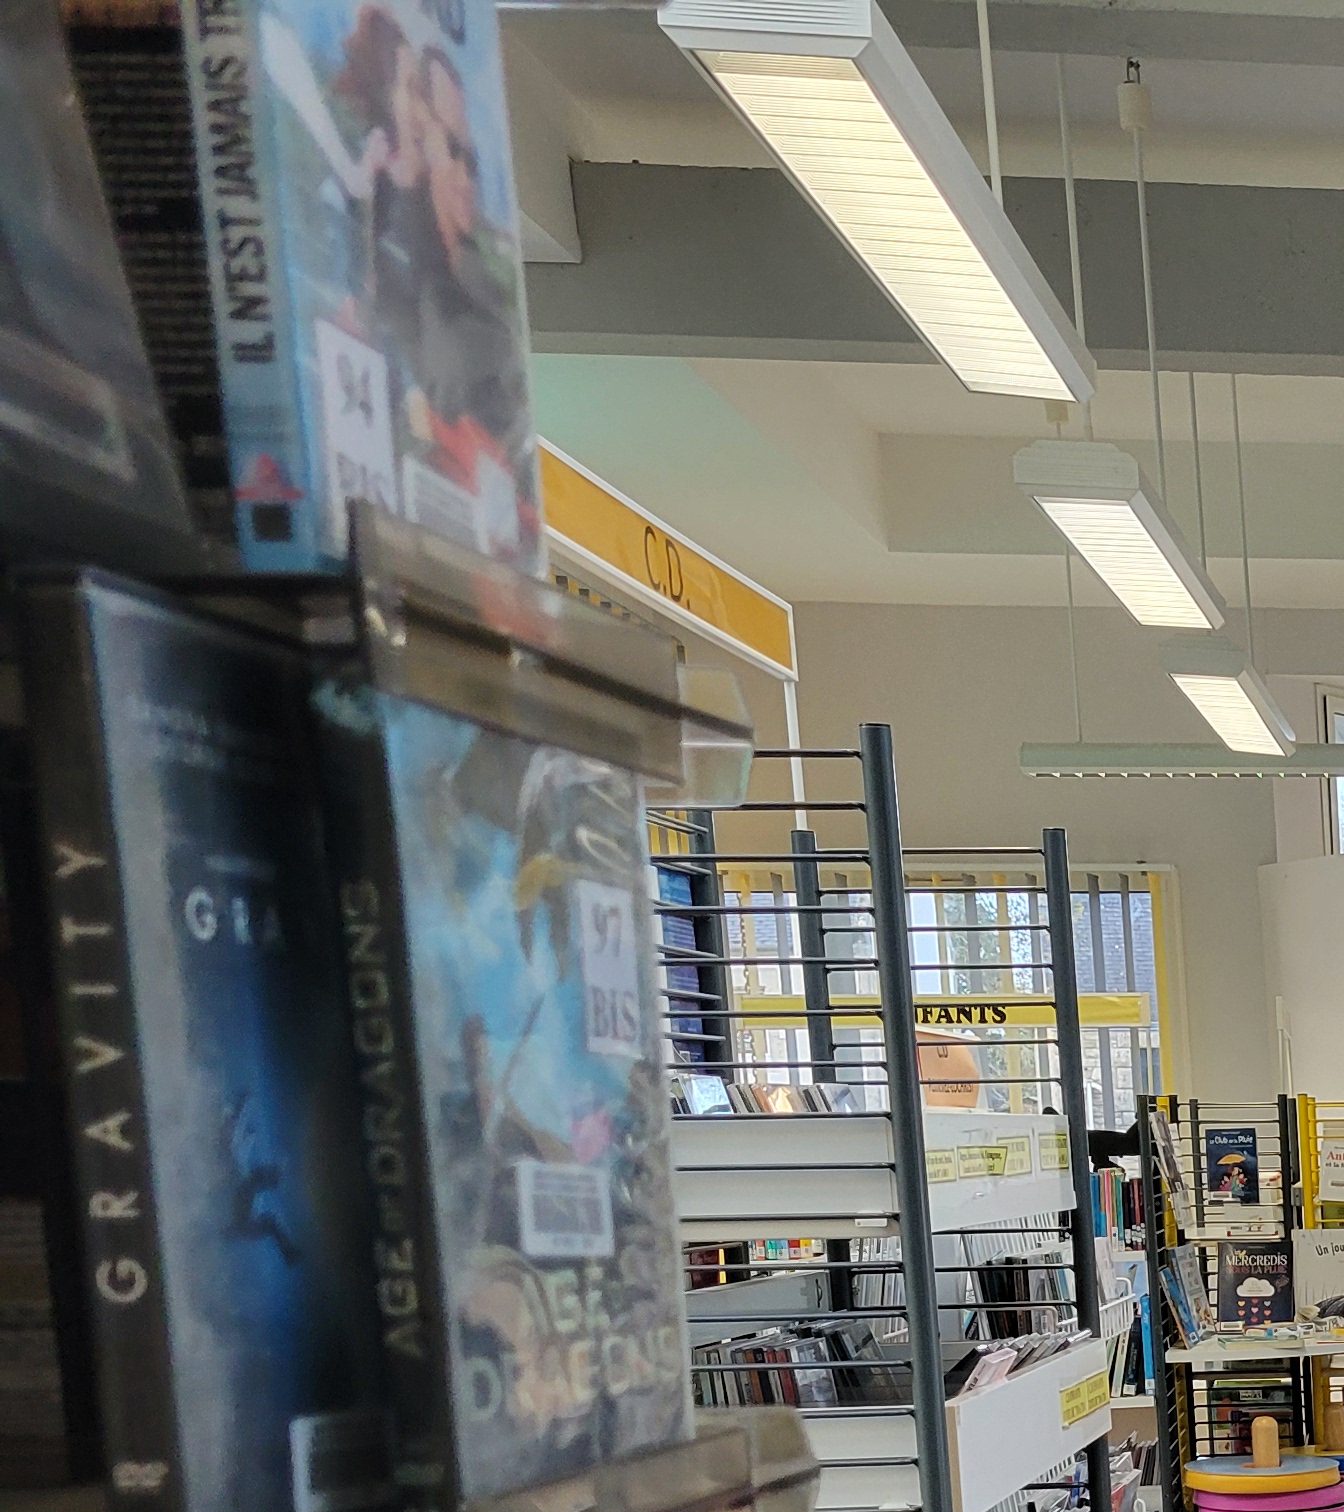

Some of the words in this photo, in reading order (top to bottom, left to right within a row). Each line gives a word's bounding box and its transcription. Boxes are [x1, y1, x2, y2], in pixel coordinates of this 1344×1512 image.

[204, 54, 258, 201] JAMAIS
[232, 330, 276, 365] IL
[643, 525, 691, 611] C.D.
[914, 1002, 1007, 1025] FANTS
[51, 840, 149, 1304] GRAVITY
[1226, 1252, 1288, 1267] MERCREDIS
[1315, 1245, 1330, 1257] Un
